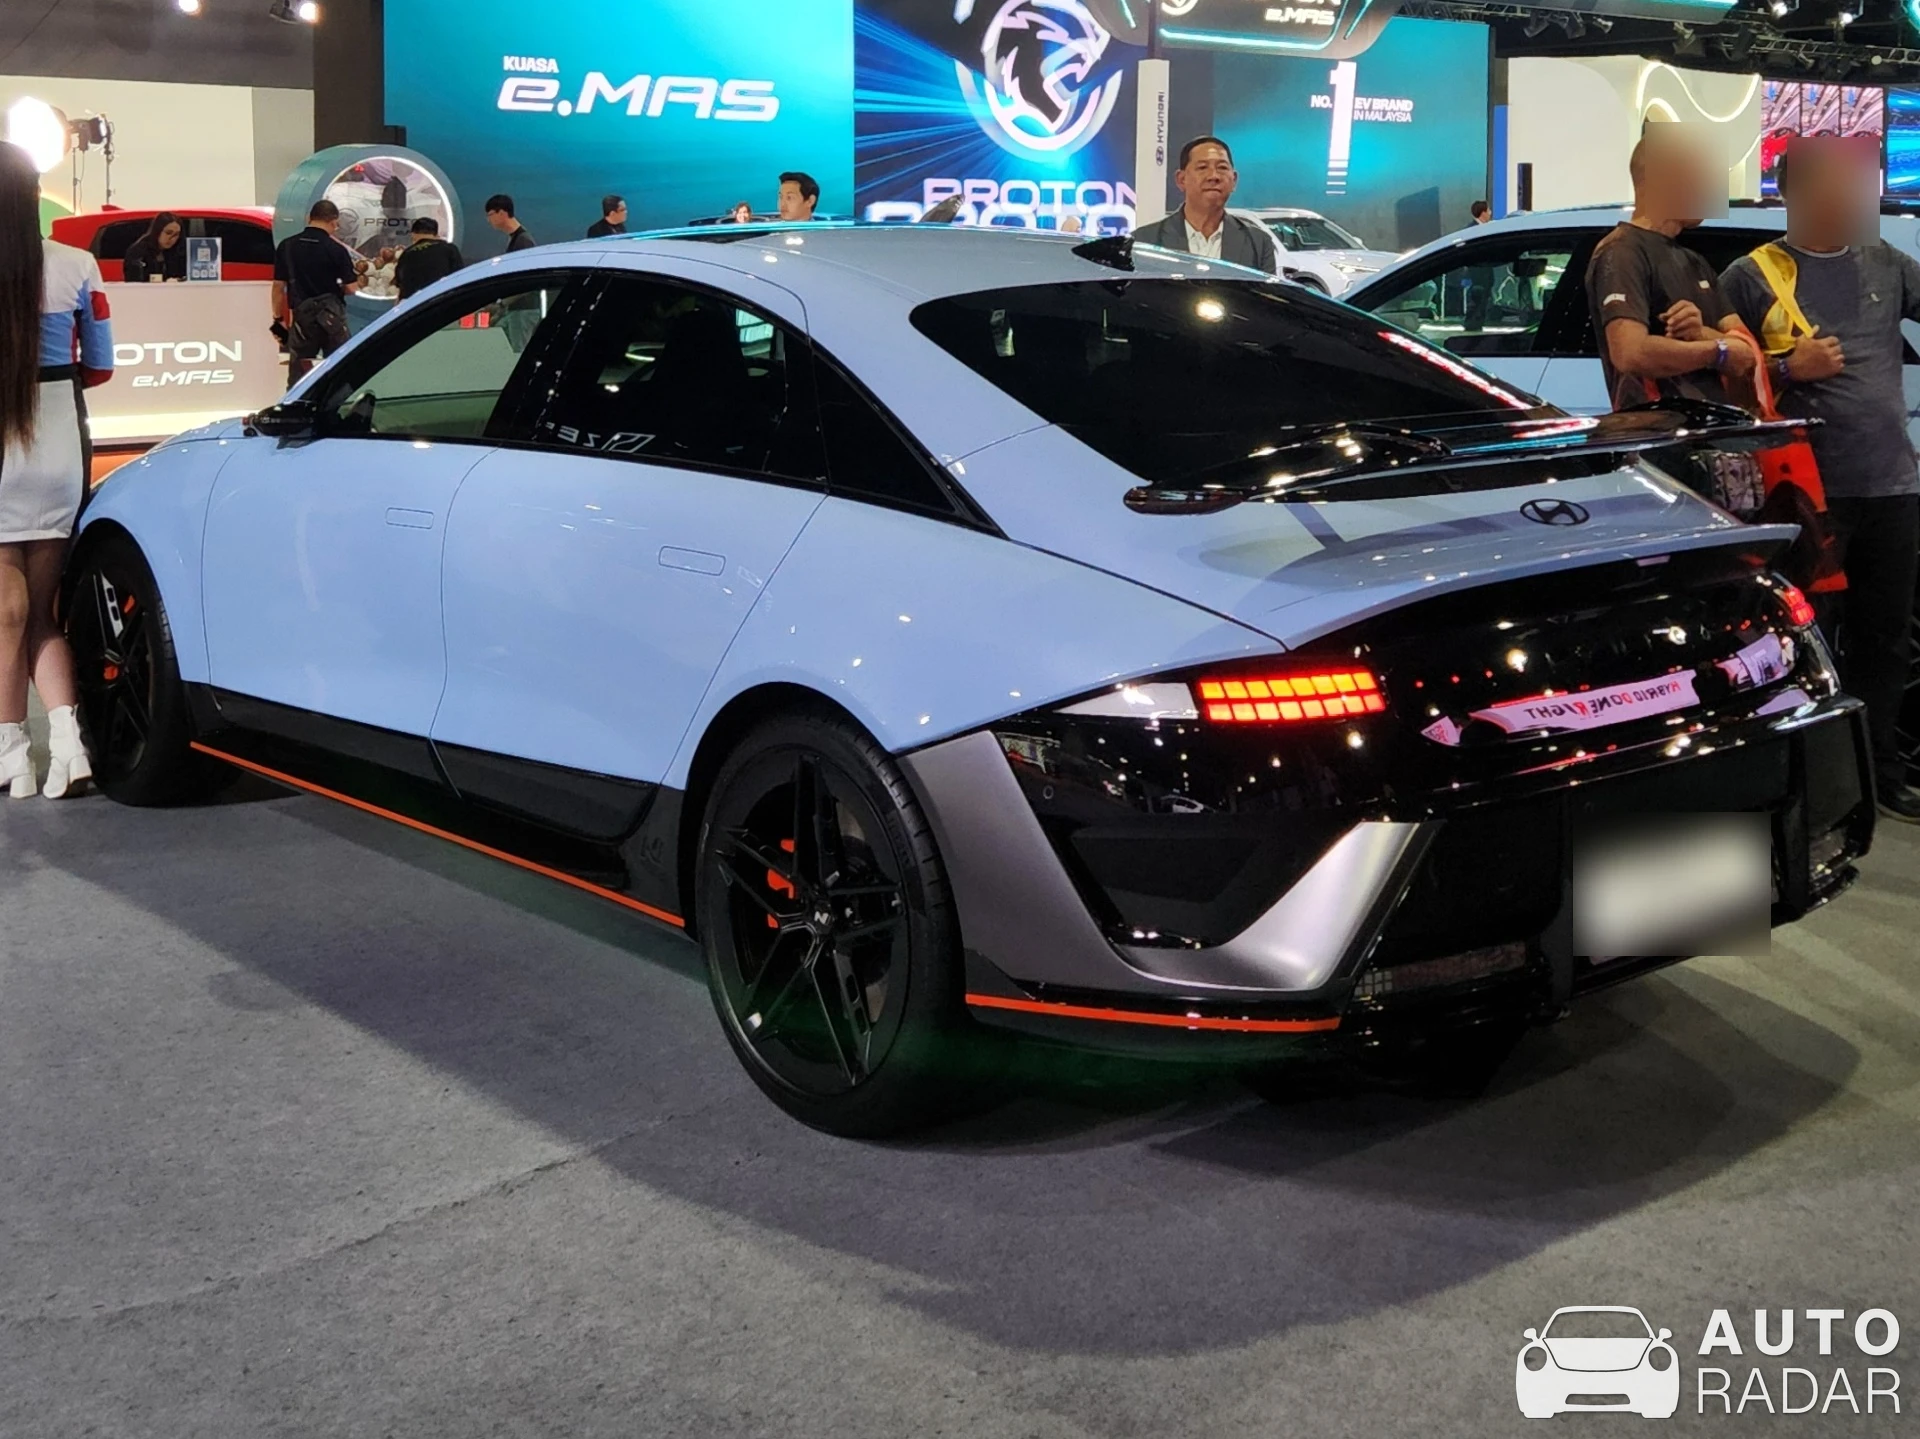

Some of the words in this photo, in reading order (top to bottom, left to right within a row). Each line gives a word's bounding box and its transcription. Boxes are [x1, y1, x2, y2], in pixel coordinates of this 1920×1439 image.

[1265, 7, 1335, 26] e.MAS
[503, 55, 560, 74] KUASA
[498, 72, 780, 122] e.MAS
[1310, 94, 1333, 108] NO.
[1354, 96, 1373, 110] EV
[1372, 98, 1414, 112] BRAND
[1156, 91, 1165, 143] HYUNDAI
[1353, 109, 1365, 121] IN
[1365, 110, 1413, 123] MALAYSIA
[364, 218, 417, 227] PROT
[113, 340, 242, 366] OTON
[132, 369, 235, 387] e.MAS
